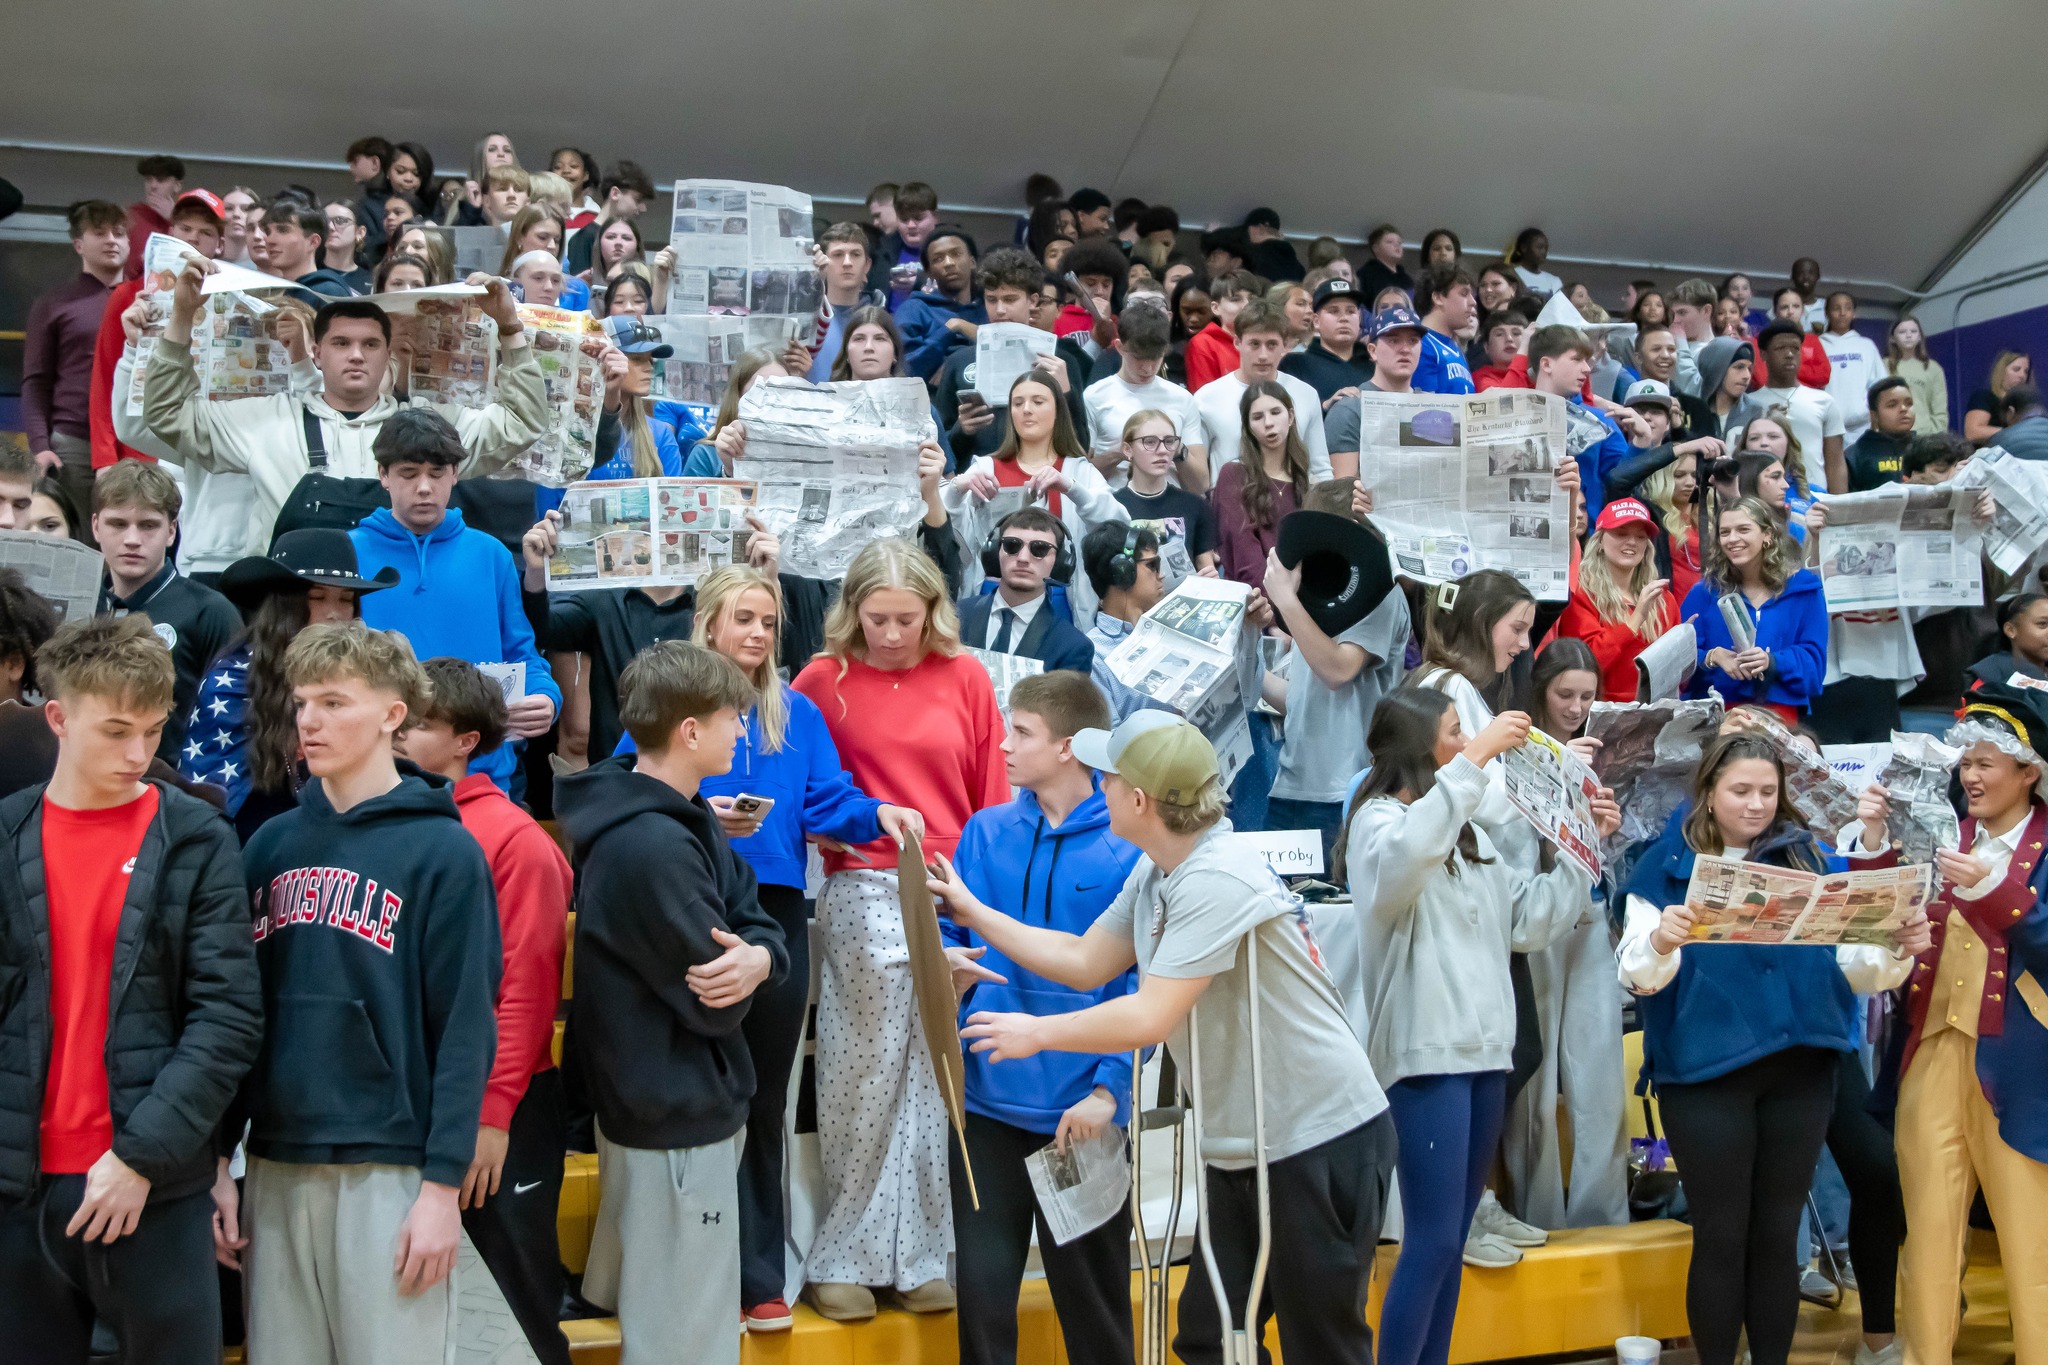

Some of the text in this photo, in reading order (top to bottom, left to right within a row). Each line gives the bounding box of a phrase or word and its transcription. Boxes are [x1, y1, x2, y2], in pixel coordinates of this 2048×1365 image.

[1466, 416, 1544, 433] The Kentucky Standard
[1611, 502, 1628, 512] MAKE
[1615, 509, 1635, 518] GREAT
[252, 866, 403, 955] LOUISVILLE
